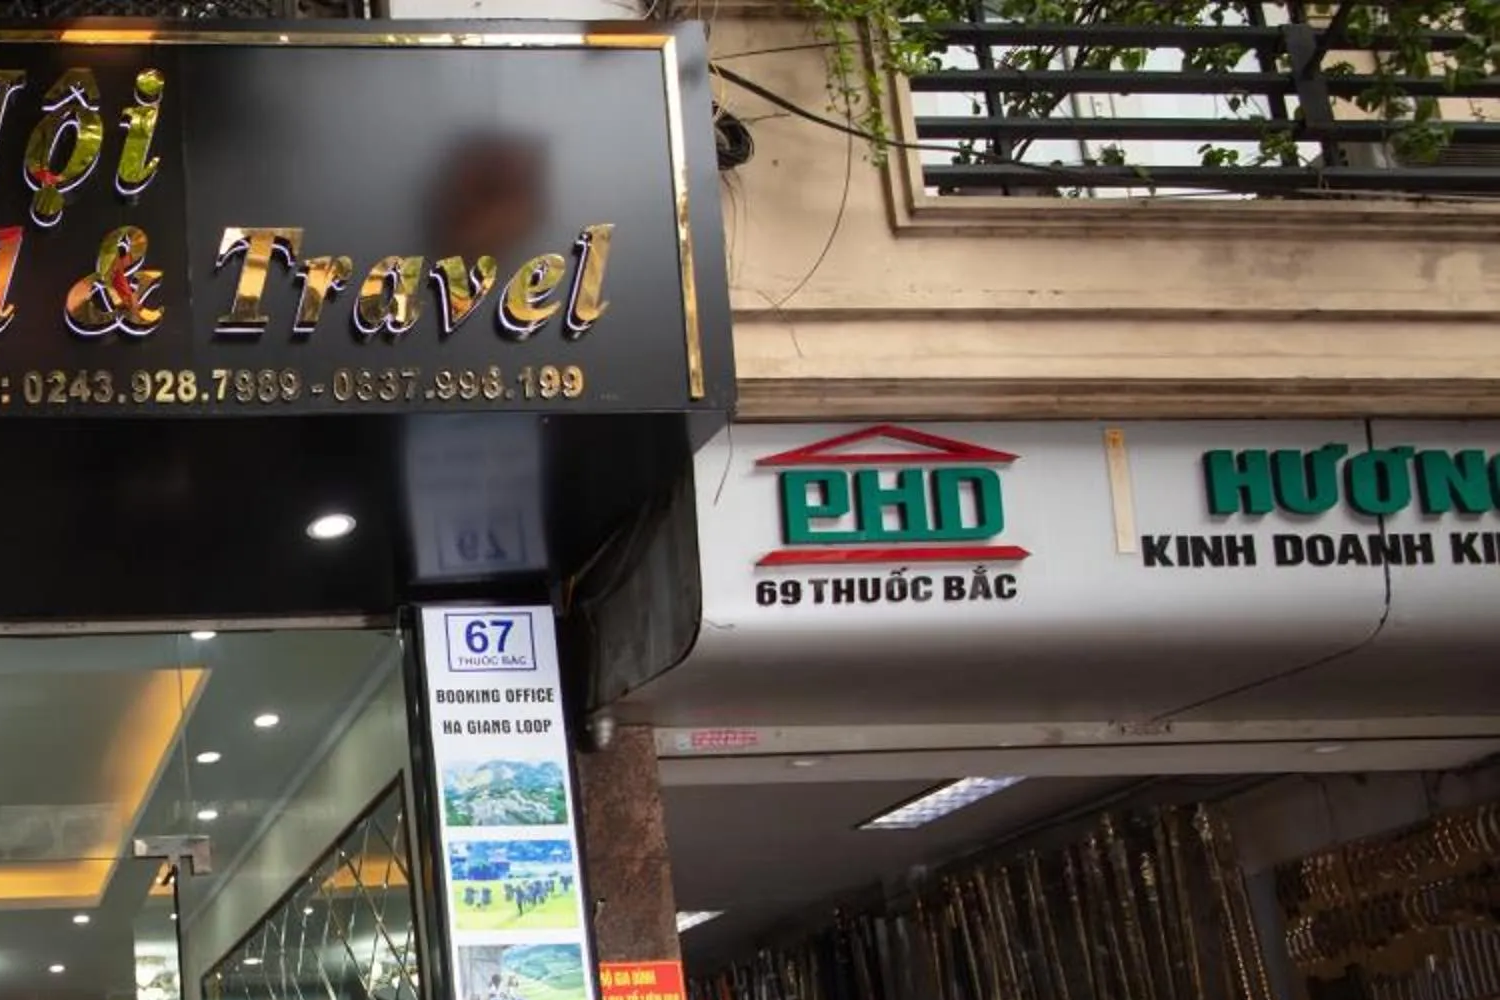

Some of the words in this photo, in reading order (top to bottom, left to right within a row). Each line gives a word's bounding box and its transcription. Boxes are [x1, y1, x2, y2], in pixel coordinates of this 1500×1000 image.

[64, 224, 164, 338] &
[214, 223, 616, 339] Travel
[778, 467, 1004, 545] PHD
[1141, 534, 1257, 567] KINH
[1273, 533, 1434, 567] DOANH
[1449, 532, 1500, 564] KI
[755, 579, 802, 606] 69
[808, 566, 933, 605] THUỐC
[943, 565, 1017, 602] BẮC
[465, 619, 514, 654] 67
[435, 689, 501, 705] BOOKING
[505, 687, 555, 704] OFFICE
[443, 720, 462, 735] HA
[467, 719, 511, 735] GIANG
[515, 719, 552, 735] LOOP
